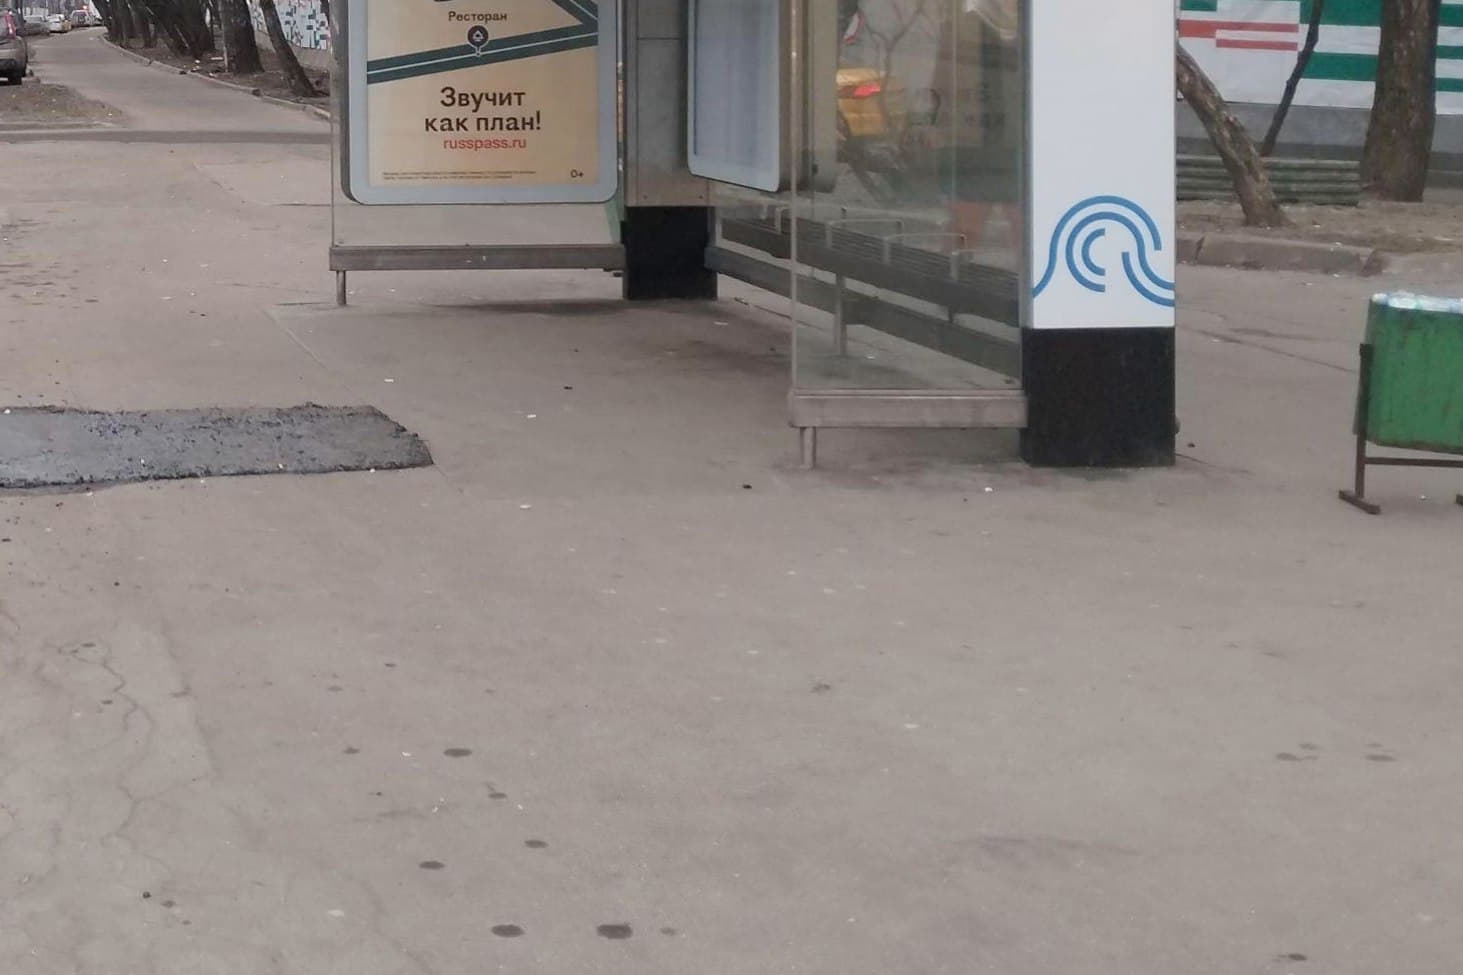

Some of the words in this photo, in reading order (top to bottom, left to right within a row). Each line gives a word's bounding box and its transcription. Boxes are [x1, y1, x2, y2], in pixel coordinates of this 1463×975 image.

[448, 10, 508, 22] Ресторан
[440, 86, 526, 113] Звучит
[424, 116, 469, 132] как
[476, 109, 542, 132] план!
[443, 137, 527, 151] russpass.ru
[570, 169, 584, 179] 0+
